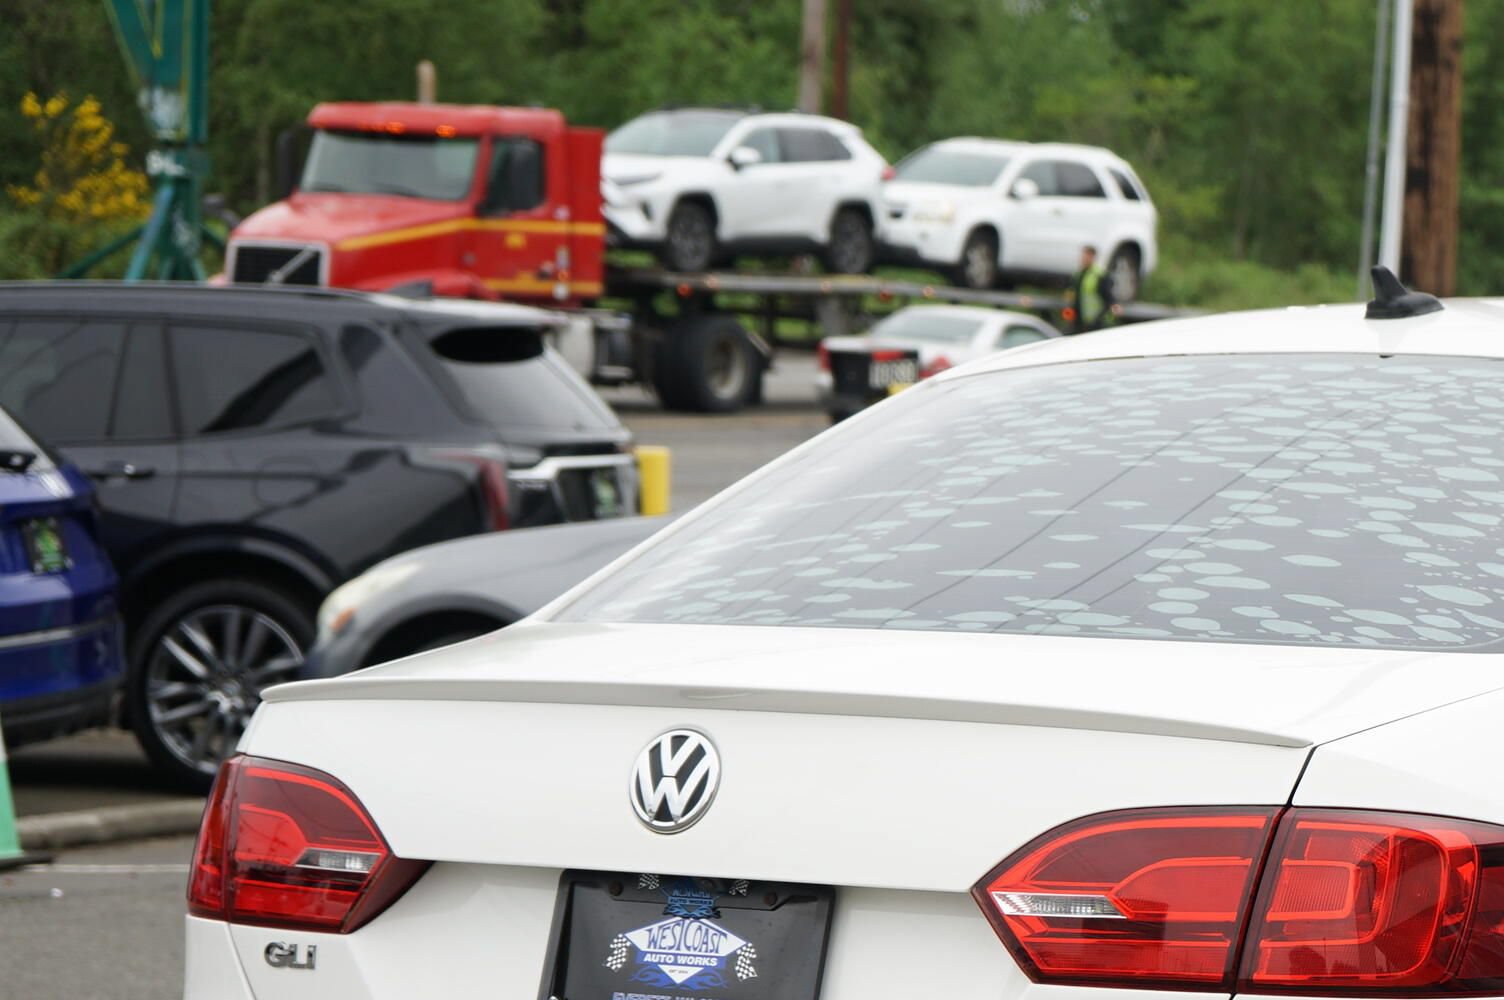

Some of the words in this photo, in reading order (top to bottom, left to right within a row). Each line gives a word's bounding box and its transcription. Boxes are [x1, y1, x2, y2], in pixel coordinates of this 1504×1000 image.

[264, 941, 317, 970] GLI
[643, 952, 675, 964] AUTO
[677, 955, 718, 967] WORKS
